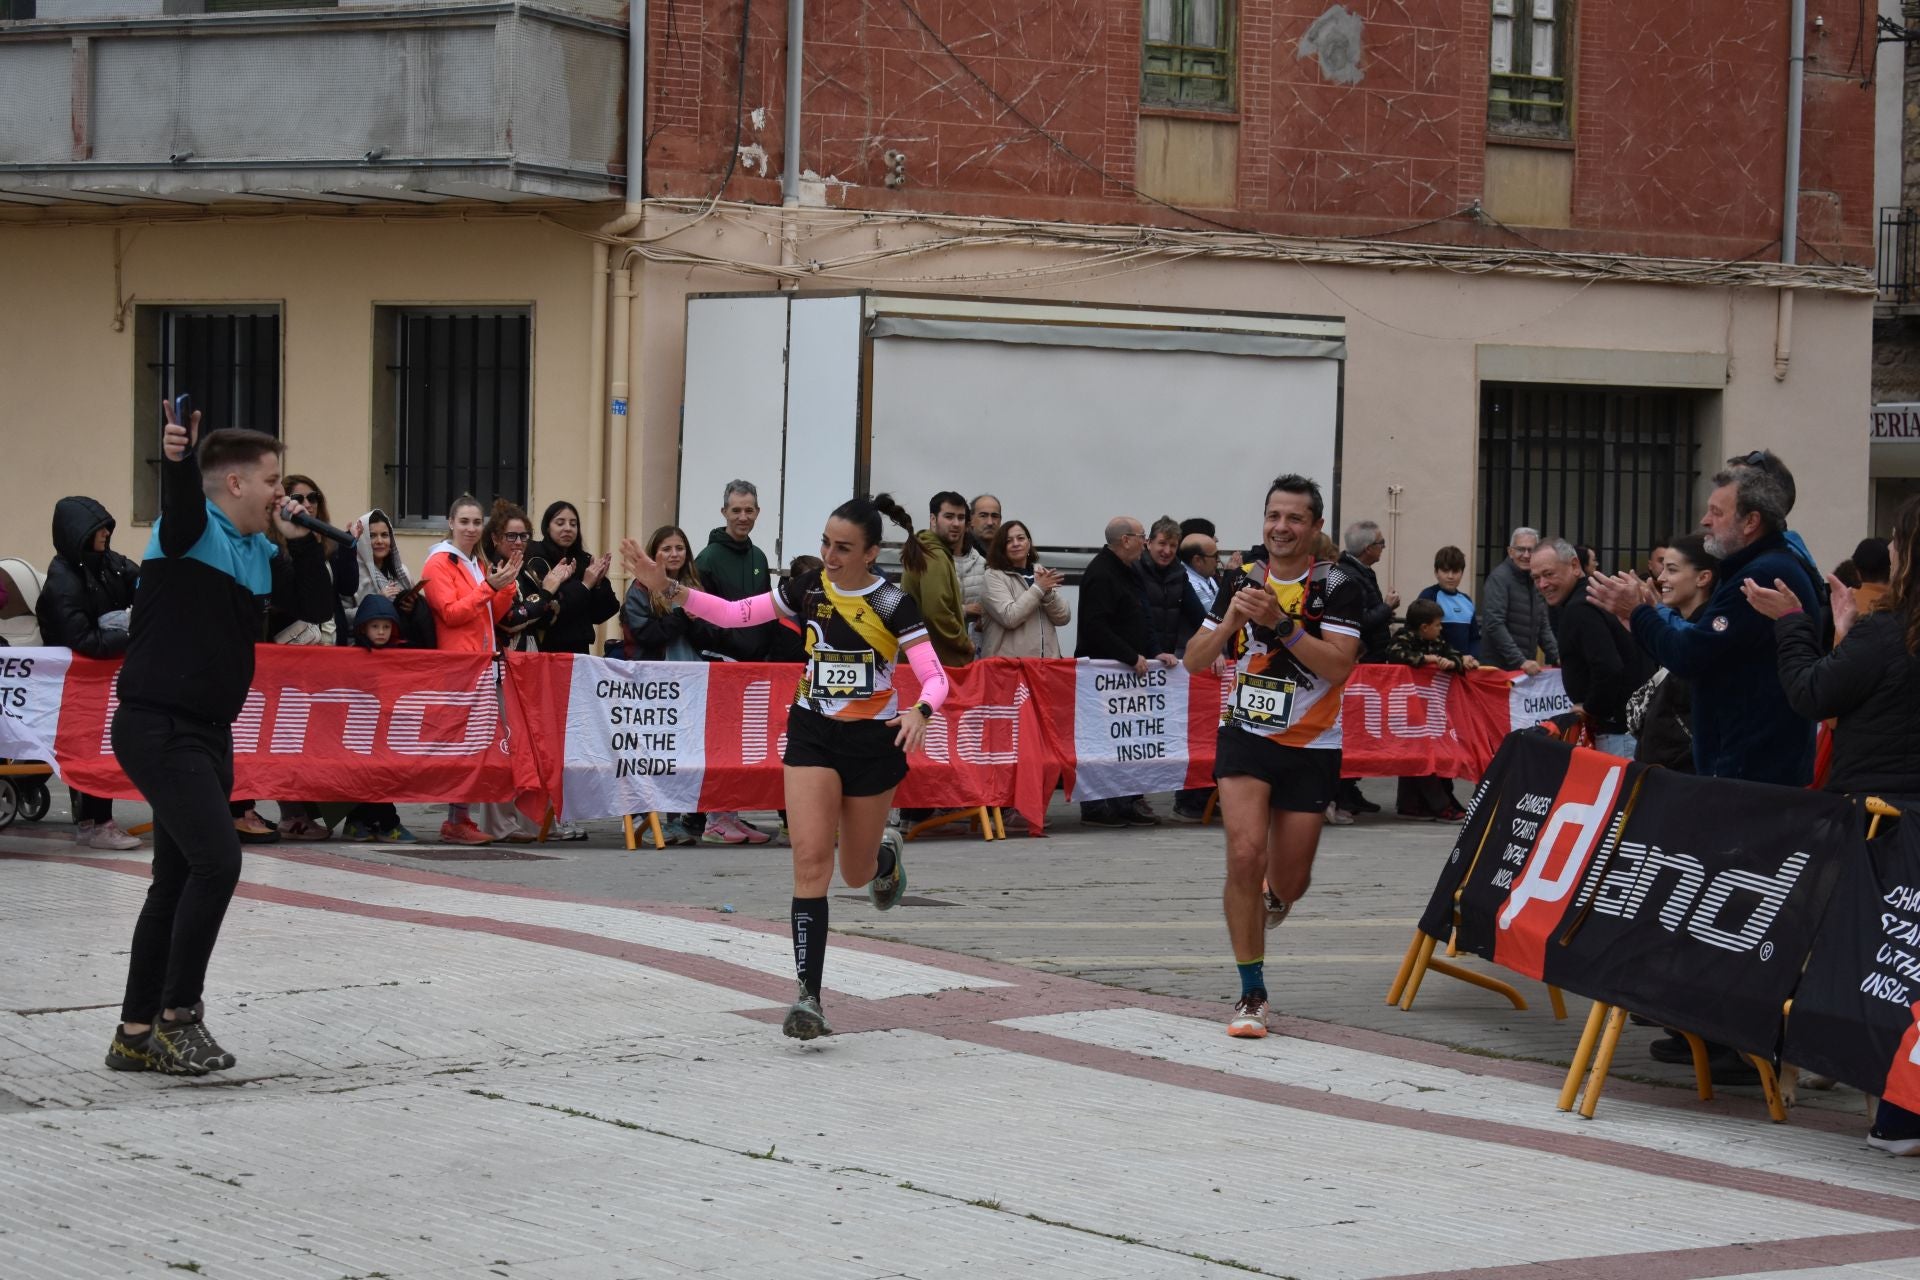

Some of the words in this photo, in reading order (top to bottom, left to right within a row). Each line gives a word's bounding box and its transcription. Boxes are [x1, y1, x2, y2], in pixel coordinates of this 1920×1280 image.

[1870, 407, 1920, 438] ERÍA
[826, 669, 857, 685] 229
[1095, 669, 1167, 692] CHANGES
[596, 679, 680, 700] CHANGES
[1108, 694, 1166, 715] STARTS
[1247, 693, 1276, 712] 230
[610, 706, 678, 726] STARTS
[1110, 721, 1132, 739] ON
[1136, 718, 1165, 737] THE
[611, 732, 639, 751] ON
[642, 733, 677, 751] THE
[1117, 742, 1166, 763] INSIDE
[616, 758, 677, 778] INSIDE
